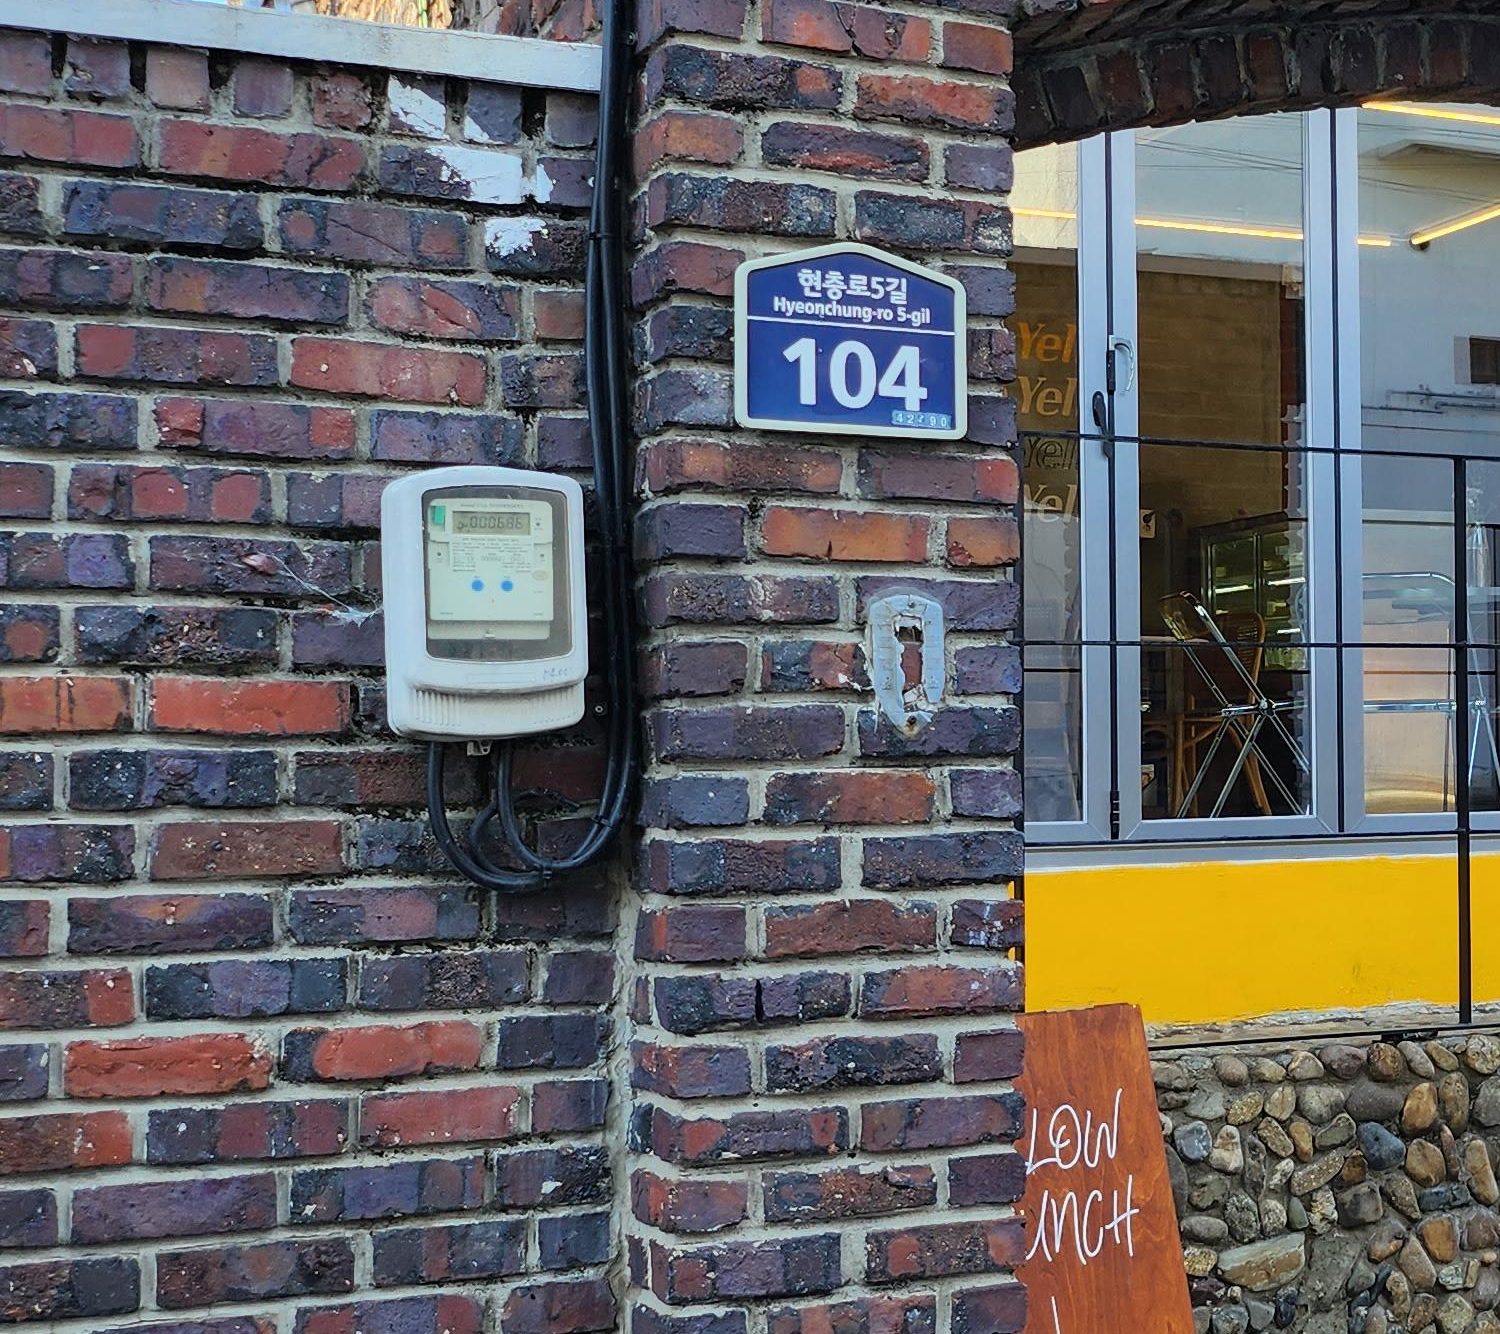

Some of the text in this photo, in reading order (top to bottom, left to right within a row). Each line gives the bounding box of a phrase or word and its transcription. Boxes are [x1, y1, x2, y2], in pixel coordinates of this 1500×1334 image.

[797, 268, 908, 305] 현충로5길
[773, 296, 931, 327] Hyeonchung-ro 5-gil
[782, 337, 928, 412] 104
